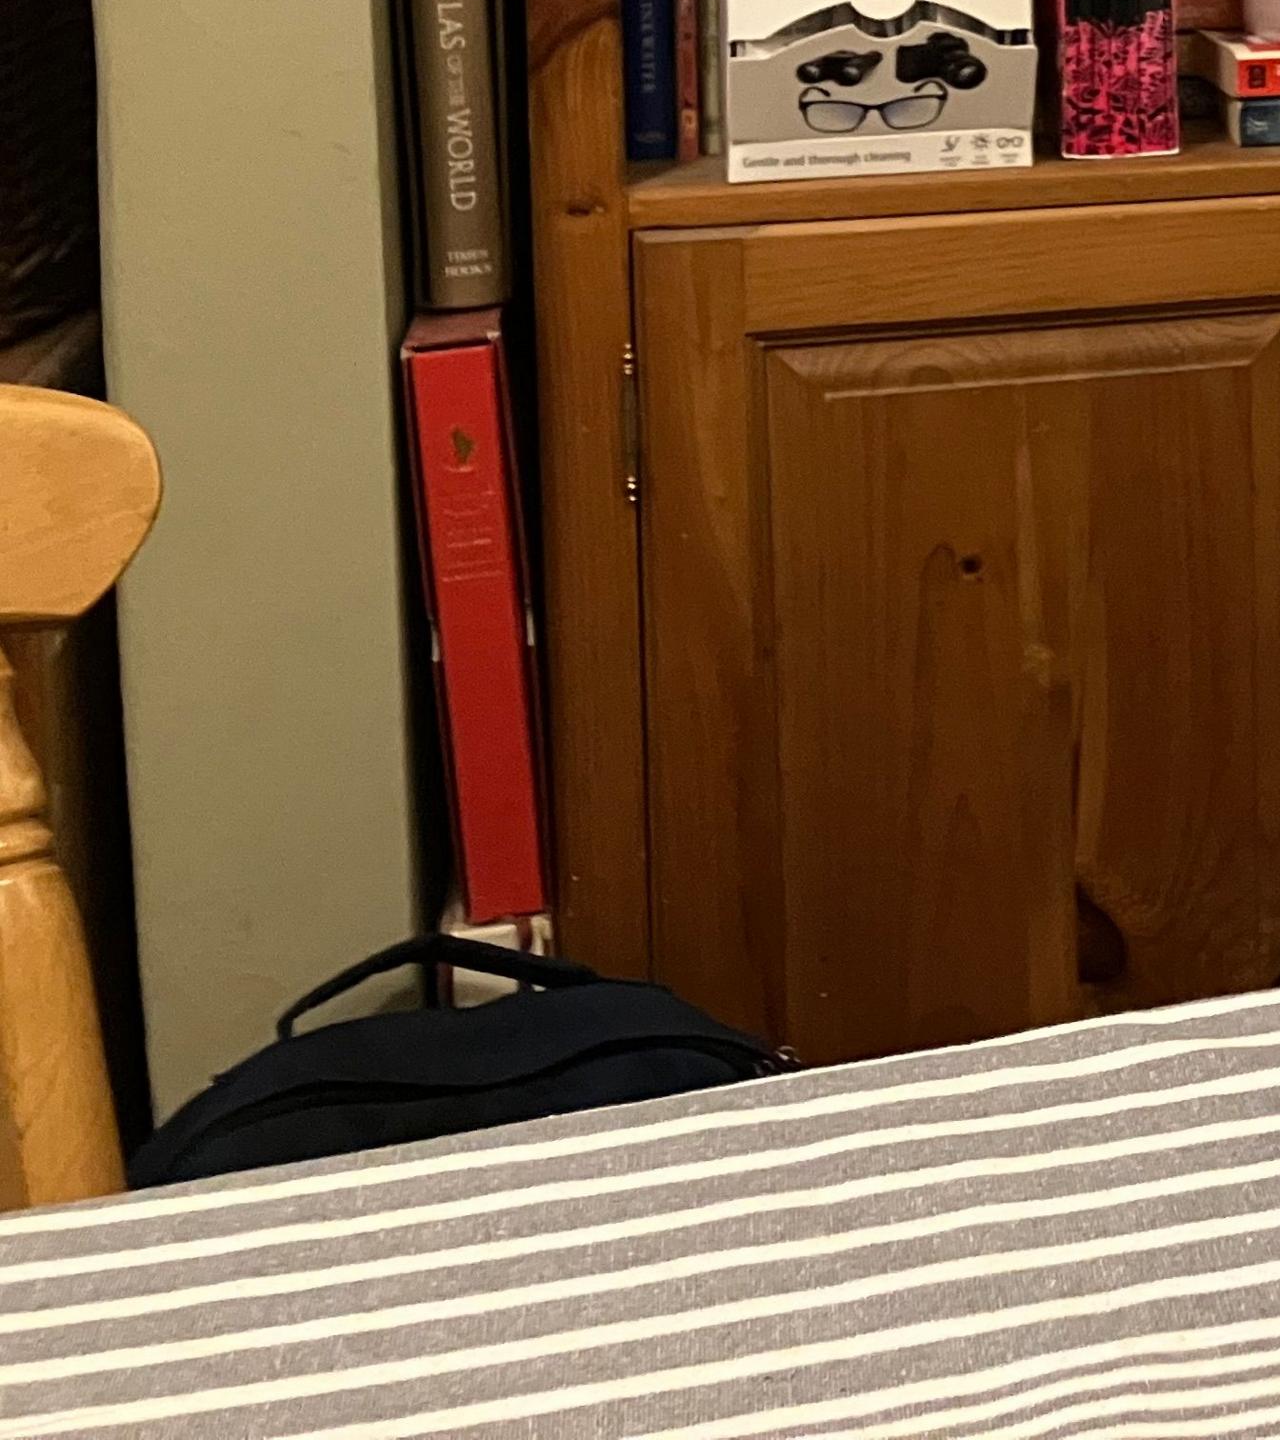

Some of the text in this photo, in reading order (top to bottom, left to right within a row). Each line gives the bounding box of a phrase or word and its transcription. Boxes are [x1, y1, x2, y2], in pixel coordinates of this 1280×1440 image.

[447, 108, 478, 212] WORLD
[743, 150, 912, 168] Gentle and thorough cleaning
